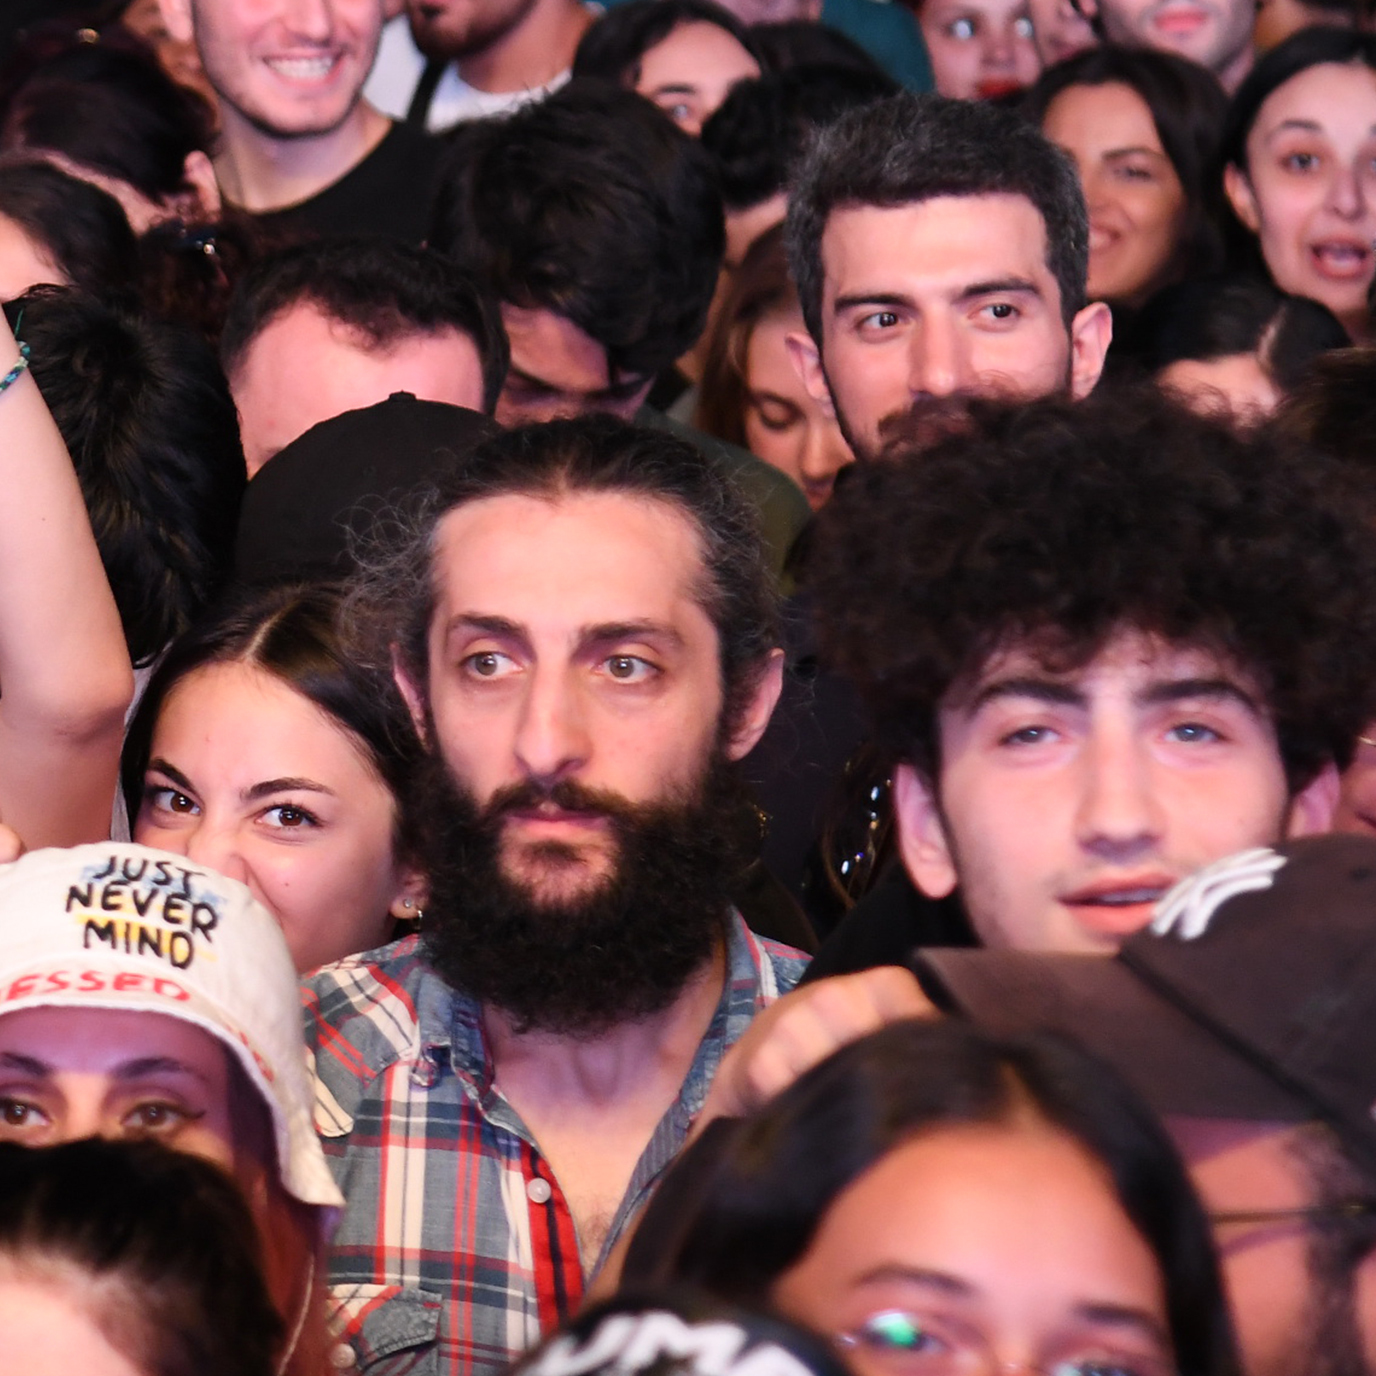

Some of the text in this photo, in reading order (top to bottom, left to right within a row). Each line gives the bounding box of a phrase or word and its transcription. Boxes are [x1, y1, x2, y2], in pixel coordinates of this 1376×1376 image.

[93, 855, 208, 899] JUST
[65, 879, 219, 944] NEVER
[83, 918, 195, 970] MIND
